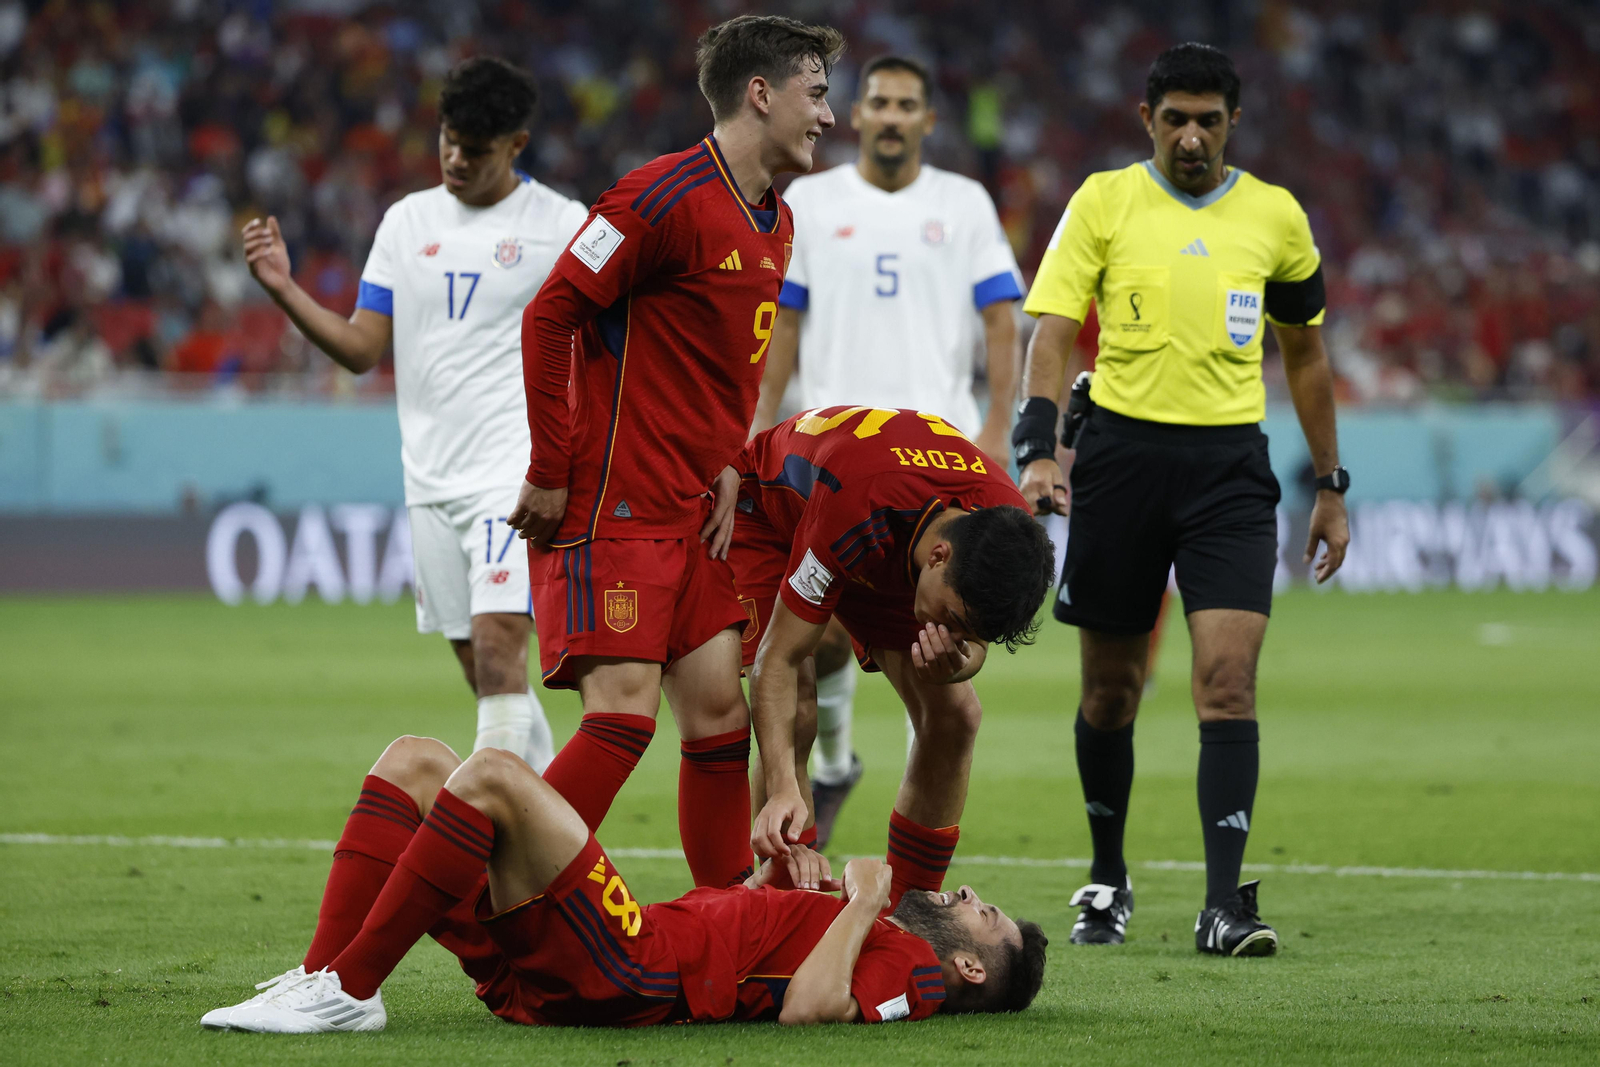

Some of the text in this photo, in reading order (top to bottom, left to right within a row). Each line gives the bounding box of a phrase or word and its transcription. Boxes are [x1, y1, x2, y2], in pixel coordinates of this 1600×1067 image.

[875, 253, 899, 298] 5
[444, 271, 482, 320] 17
[1230, 293, 1257, 309] FIFA
[750, 301, 778, 364] 9
[1229, 315, 1257, 326] REFEREE
[889, 447, 988, 475] PEDRI
